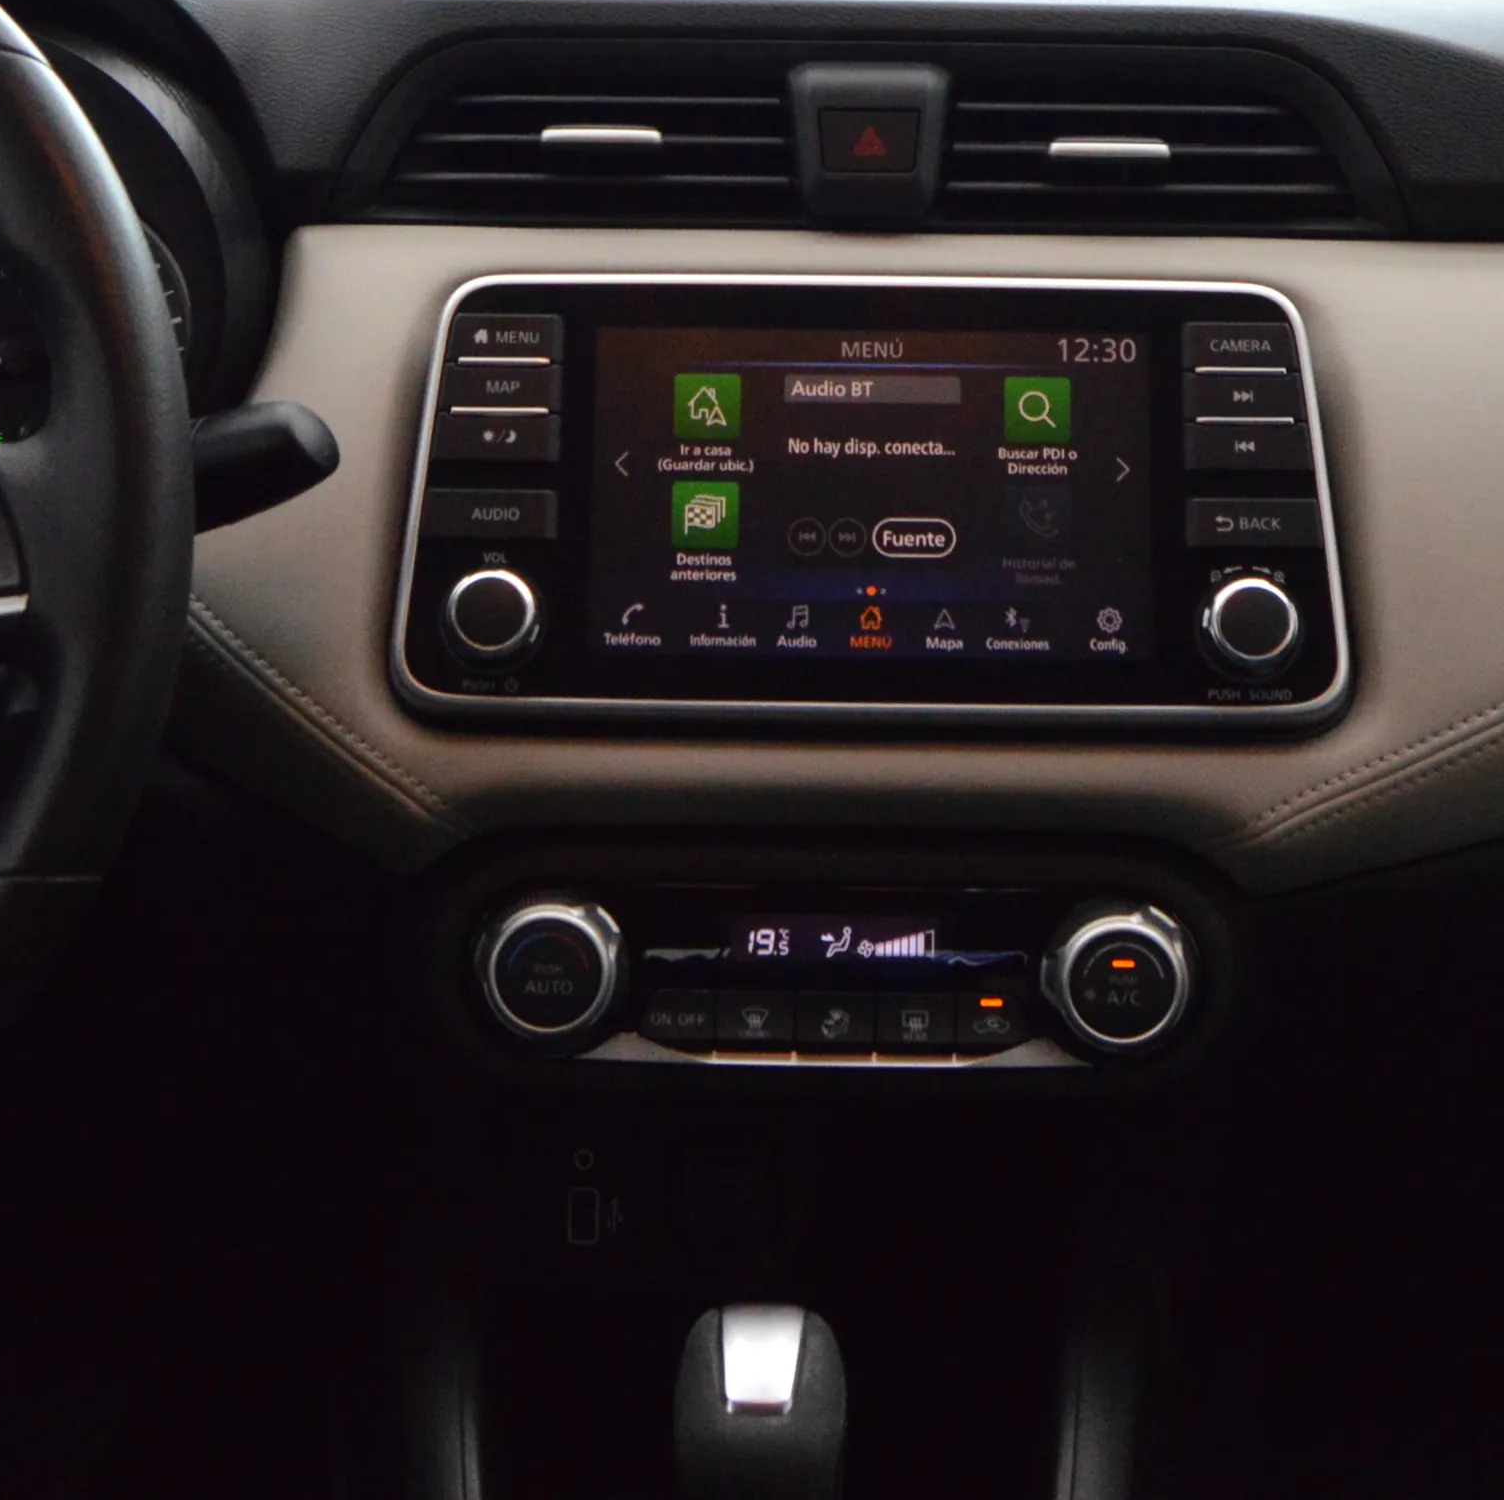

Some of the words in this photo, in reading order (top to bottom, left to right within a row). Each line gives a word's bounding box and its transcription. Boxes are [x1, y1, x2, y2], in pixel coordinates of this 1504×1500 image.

[495, 331, 540, 345] MENU
[841, 338, 904, 359] MENÚ
[1057, 338, 1137, 363] 12:30
[1210, 339, 1271, 353] CAMERA
[486, 380, 520, 394] MAP
[791, 379, 846, 397] Audio
[851, 381, 874, 398] BT
[680, 444, 690, 456] Ir
[693, 447, 701, 456] a
[704, 447, 732, 456] casa
[788, 438, 809, 454] No
[814, 437, 841, 458] hay
[844, 437, 881, 458] disp.
[884, 441, 956, 456] conecta...
[998, 447, 1040, 460] Buscar
[1043, 448, 1065, 460] PDI
[1068, 451, 1078, 460] o
[657, 458, 716, 472] (Guardar
[719, 458, 755, 473] ubic.)
[1007, 462, 1068, 475] Dirección
[471, 507, 520, 521] AUDIO
[1239, 517, 1282, 531] BACK
[883, 530, 946, 548] Fuente
[483, 552, 509, 564] VOL
[676, 553, 733, 566] Destinos
[1059, 556, 1077, 570] de
[670, 568, 737, 582] anteriores
[603, 631, 662, 646] Teléfono
[689, 633, 757, 648] Información
[776, 634, 818, 648] Audio
[850, 633, 893, 649] MENÚ
[925, 637, 964, 651] Mapa
[985, 637, 1050, 650] Conexiones
[1090, 637, 1129, 654] Config.
[1207, 687, 1241, 701] PUSH
[1248, 688, 1293, 702] SOUND
[524, 979, 574, 995] AUTO
[1107, 989, 1141, 1007] A/C
[677, 1013, 705, 1028] OFF
